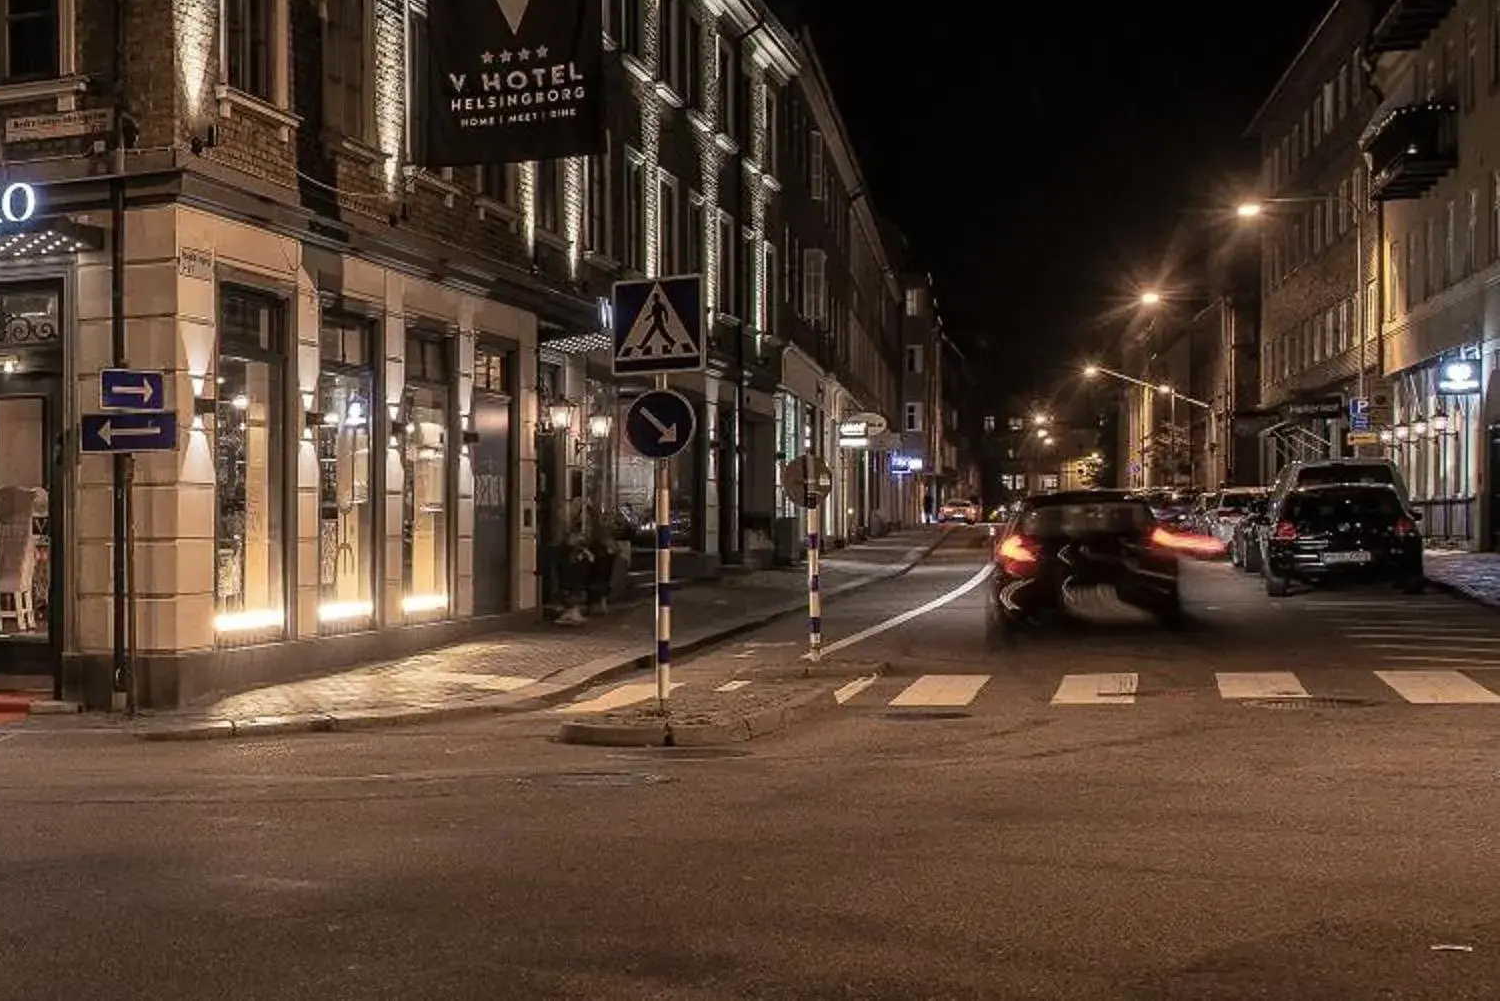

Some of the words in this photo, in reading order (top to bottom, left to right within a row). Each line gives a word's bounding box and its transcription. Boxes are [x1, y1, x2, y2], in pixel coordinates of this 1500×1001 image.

[449, 72, 468, 93] V
[481, 61, 584, 92] HOTEL
[450, 86, 586, 112] HELSINGBORG
[460, 116, 496, 128] HOME
[508, 111, 539, 124] MEET
